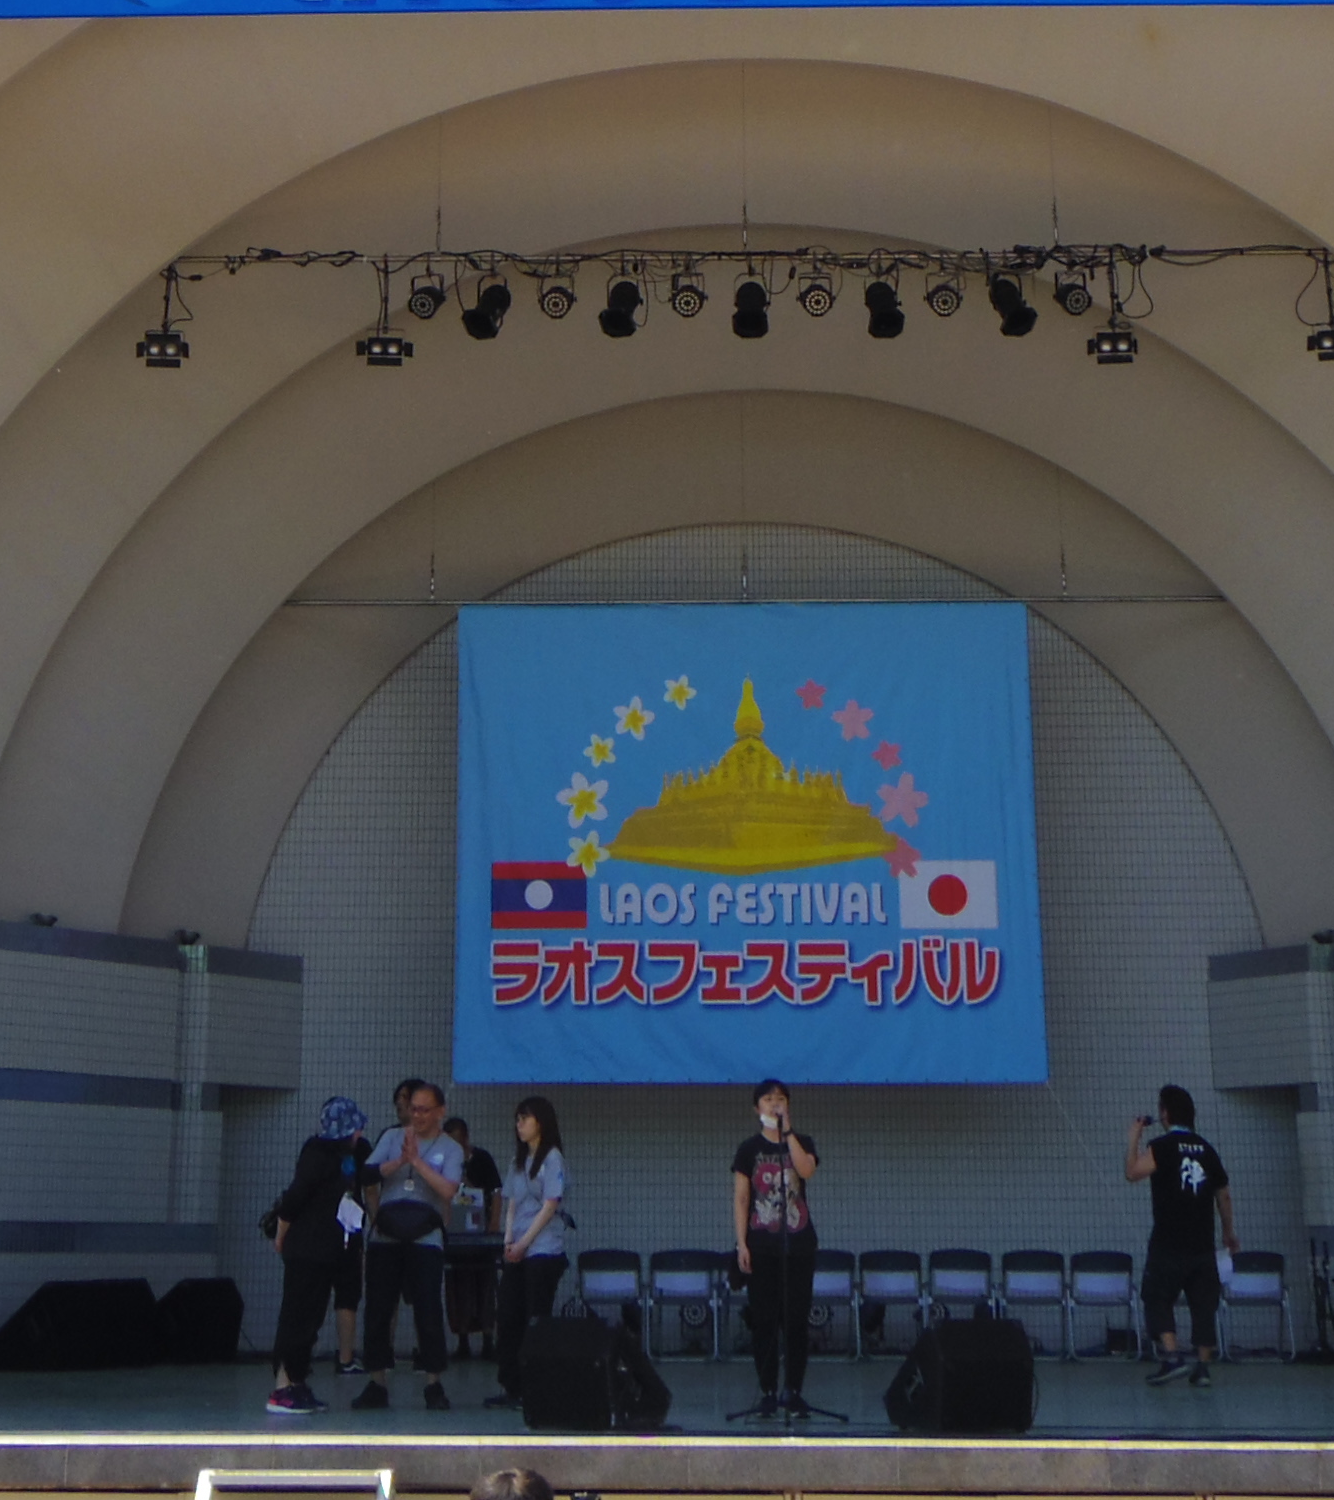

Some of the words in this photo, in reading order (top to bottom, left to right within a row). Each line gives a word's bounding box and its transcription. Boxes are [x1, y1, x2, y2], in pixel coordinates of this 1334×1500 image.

[598, 883, 696, 926] LAOS
[708, 883, 888, 926] FESTIVAL
[492, 936, 1001, 1007] ラオスフェスティバル
